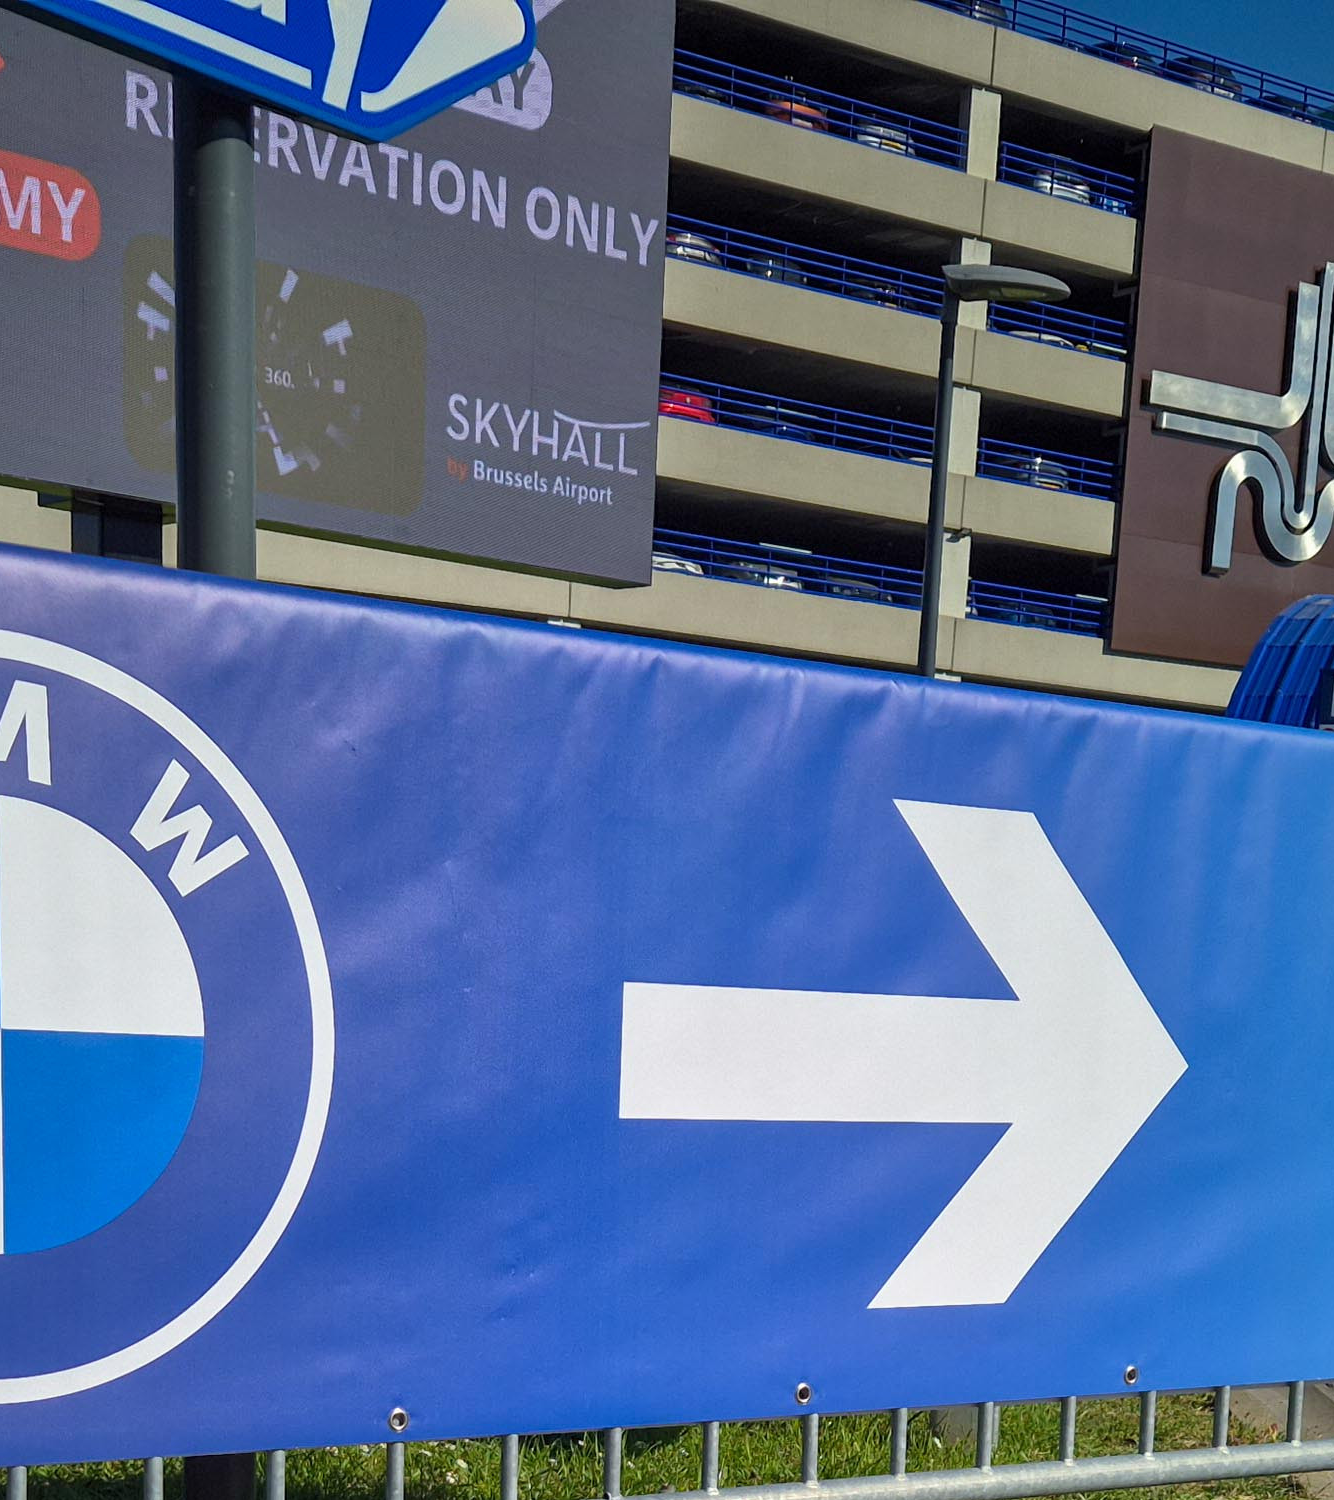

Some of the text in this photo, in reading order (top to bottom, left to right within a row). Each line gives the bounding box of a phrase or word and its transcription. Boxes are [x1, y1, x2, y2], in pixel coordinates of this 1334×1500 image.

[124, 69, 507, 230] RRVATION
[525, 185, 660, 267] ONLY
[446, 392, 640, 476] SKYHALL
[447, 455, 613, 505] by Brussels Airport
